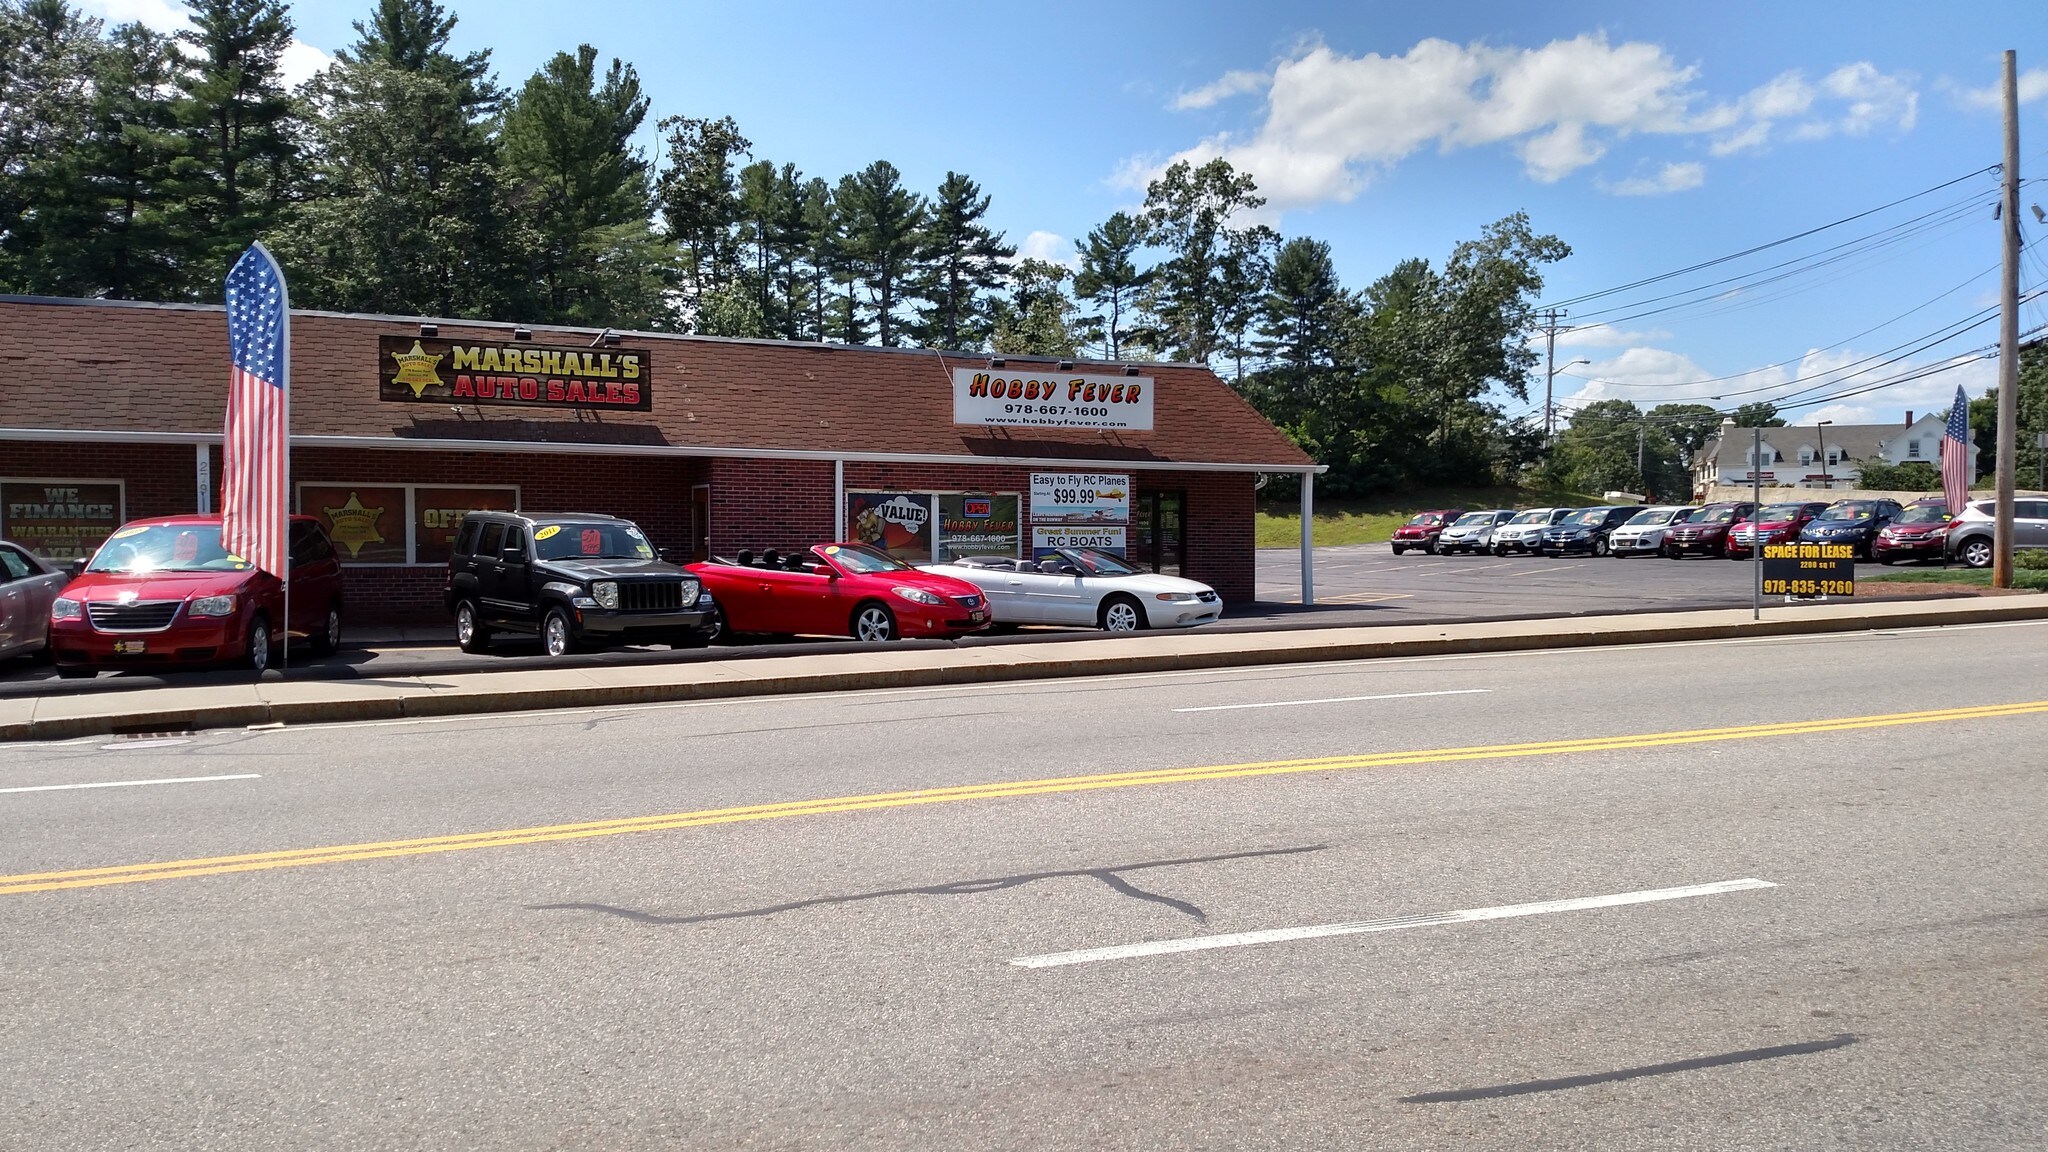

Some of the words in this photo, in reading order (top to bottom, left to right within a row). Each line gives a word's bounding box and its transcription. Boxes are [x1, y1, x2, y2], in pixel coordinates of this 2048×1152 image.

[453, 345, 640, 379] MARSHALL'S
[453, 375, 539, 400] AUTO
[547, 379, 641, 404] SALES
[969, 373, 1057, 401] HOBBY
[1068, 379, 1141, 404] FEVER
[1004, 404, 1108, 417] 978-667-1600
[985, 416, 1128, 427] www.hobbyfever.com
[1033, 474, 1055, 487] Easy
[1057, 476, 1066, 485] to
[1068, 475, 1081, 487] Fly
[1084, 475, 1096, 485] RC
[1098, 475, 1126, 486] Planes
[44, 488, 79, 503] WE
[1054, 488, 1095, 505] $99.99
[9, 504, 113, 519] FINANCE
[881, 505, 926, 522] VALUE!
[965, 503, 989, 514] OPEN
[944, 518, 979, 531] HOBBY
[983, 519, 1014, 532] FEVER
[11, 526, 112, 538] WARRANTIES
[539, 528, 556, 539] 2011
[952, 534, 1006, 543] 978-667-1600
[947, 543, 1010, 551] www.hobbyfever.com
[1047, 536, 1066, 546] RC
[1070, 536, 1112, 546] BOATS
[1764, 545, 1798, 559] SPACE
[1799, 545, 1820, 559] FOR
[1821, 545, 1853, 559] LEASE
[1818, 561, 1828, 570] sq
[1764, 580, 1853, 594] 978-835-3260
